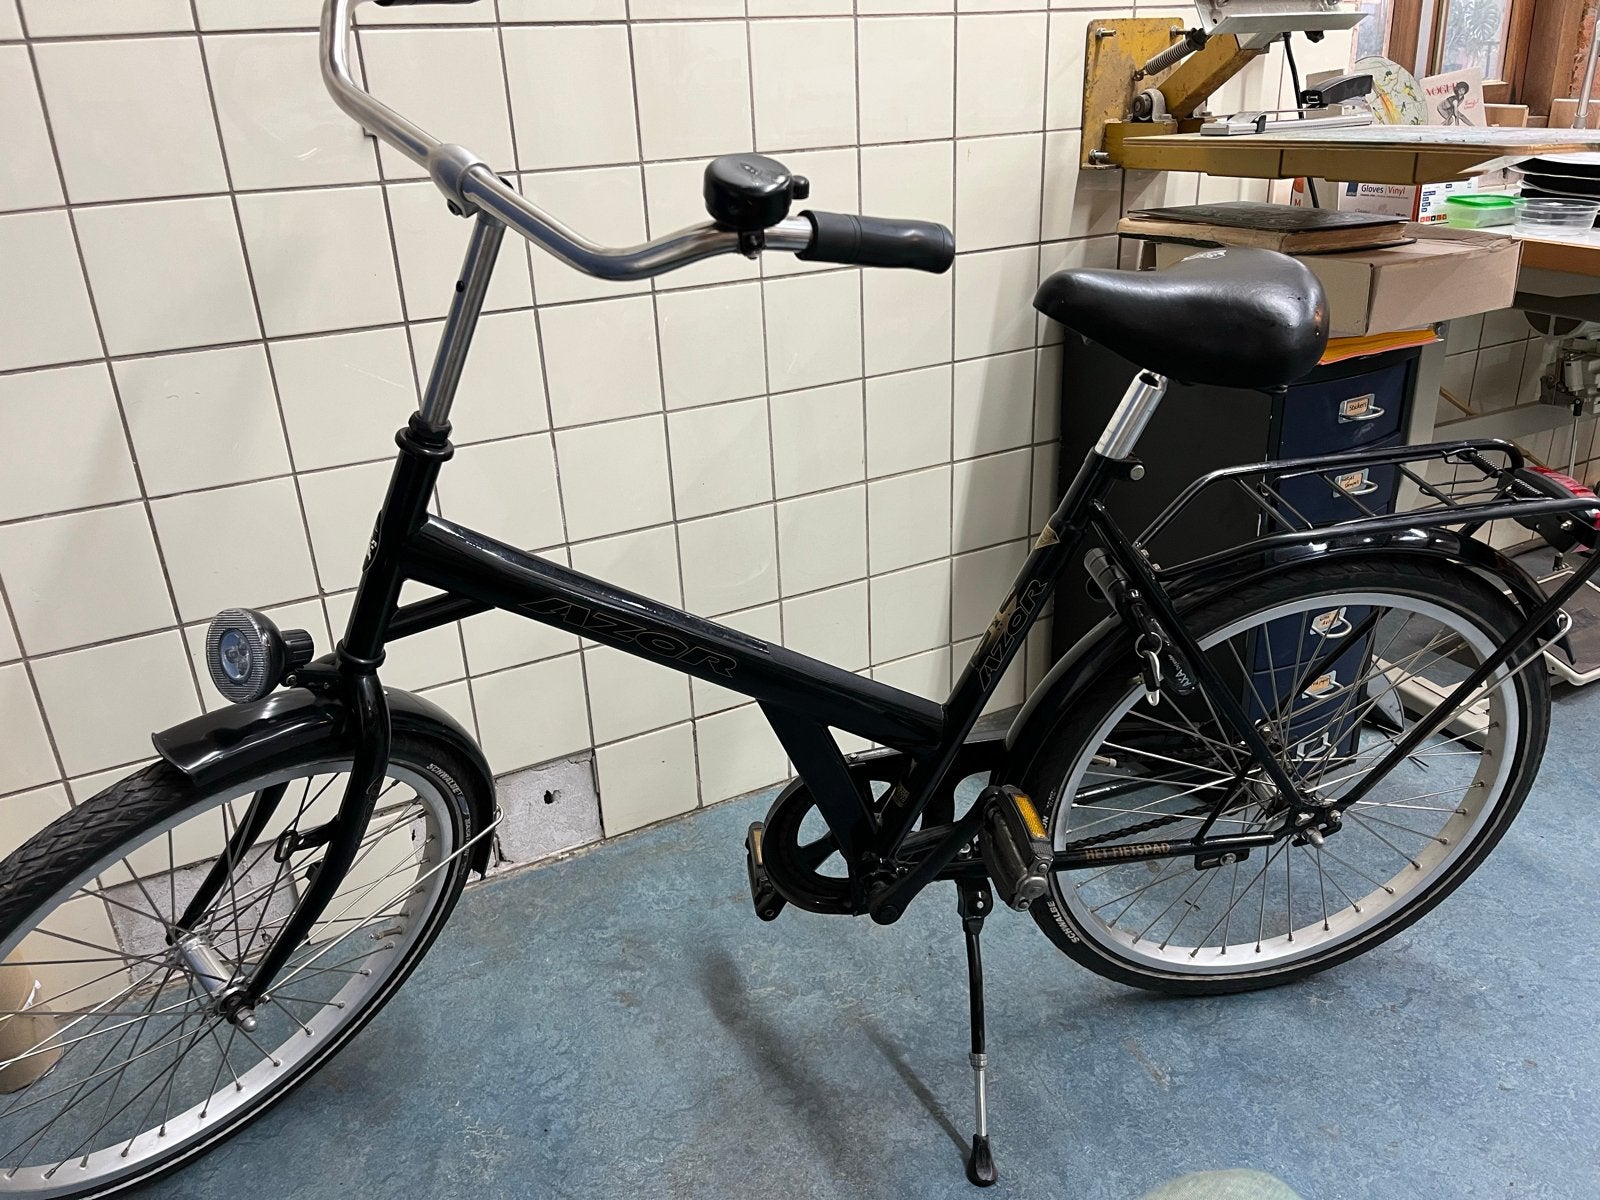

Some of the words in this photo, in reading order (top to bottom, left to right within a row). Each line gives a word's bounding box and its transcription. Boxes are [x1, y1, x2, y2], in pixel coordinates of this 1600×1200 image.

[1361, 184, 1384, 194] Gloves
[1388, 186, 1406, 197] Vinyl
[518, 597, 739, 679] AZOR
[978, 579, 1049, 693] AZOR
[1175, 669, 1192, 686] AXA
[426, 762, 462, 797] SCHWALBE
[1086, 848, 1108, 860] HET
[1112, 842, 1171, 858] FIETSPAD
[1046, 900, 1081, 944] SCHWALBE
